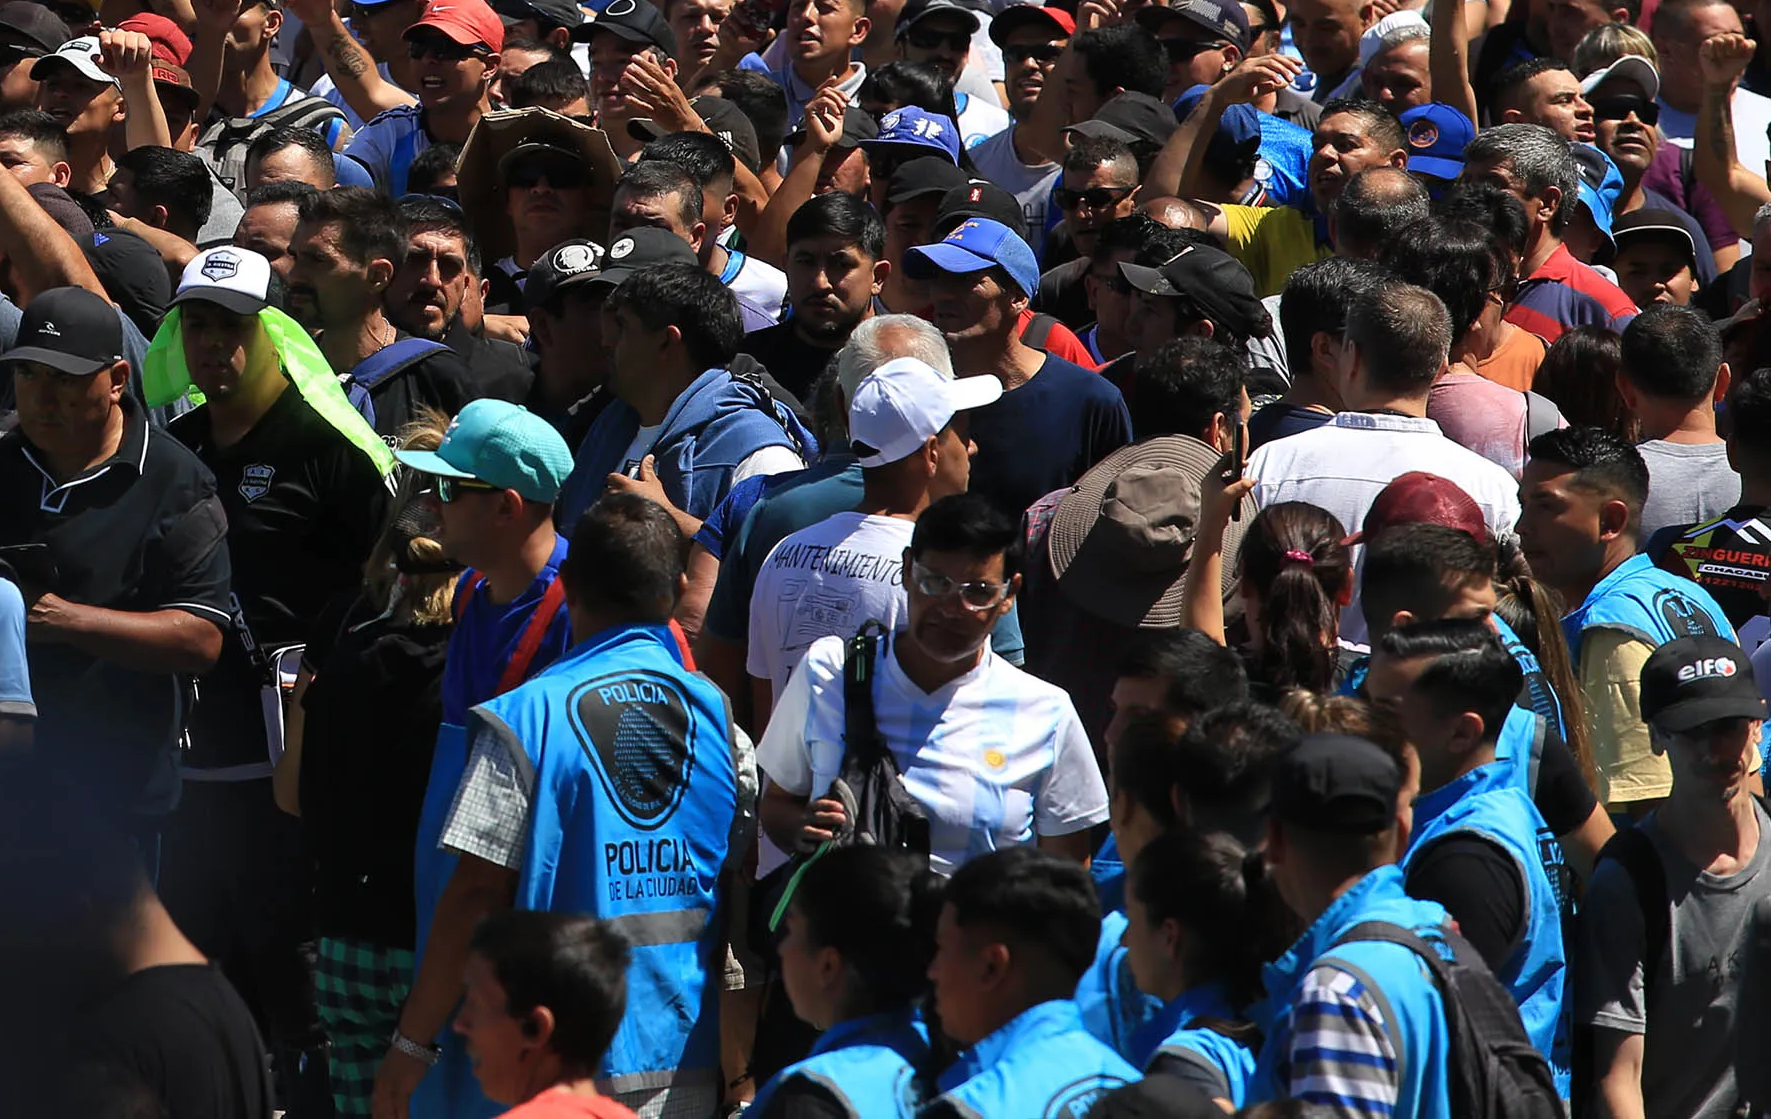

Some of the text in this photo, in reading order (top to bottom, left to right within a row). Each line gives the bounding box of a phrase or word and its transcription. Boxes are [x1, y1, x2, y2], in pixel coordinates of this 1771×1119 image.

[597, 682, 669, 706] POLICIA
[605, 838, 696, 877] POLICIA
[609, 876, 697, 901] DE LA CIUDAD
